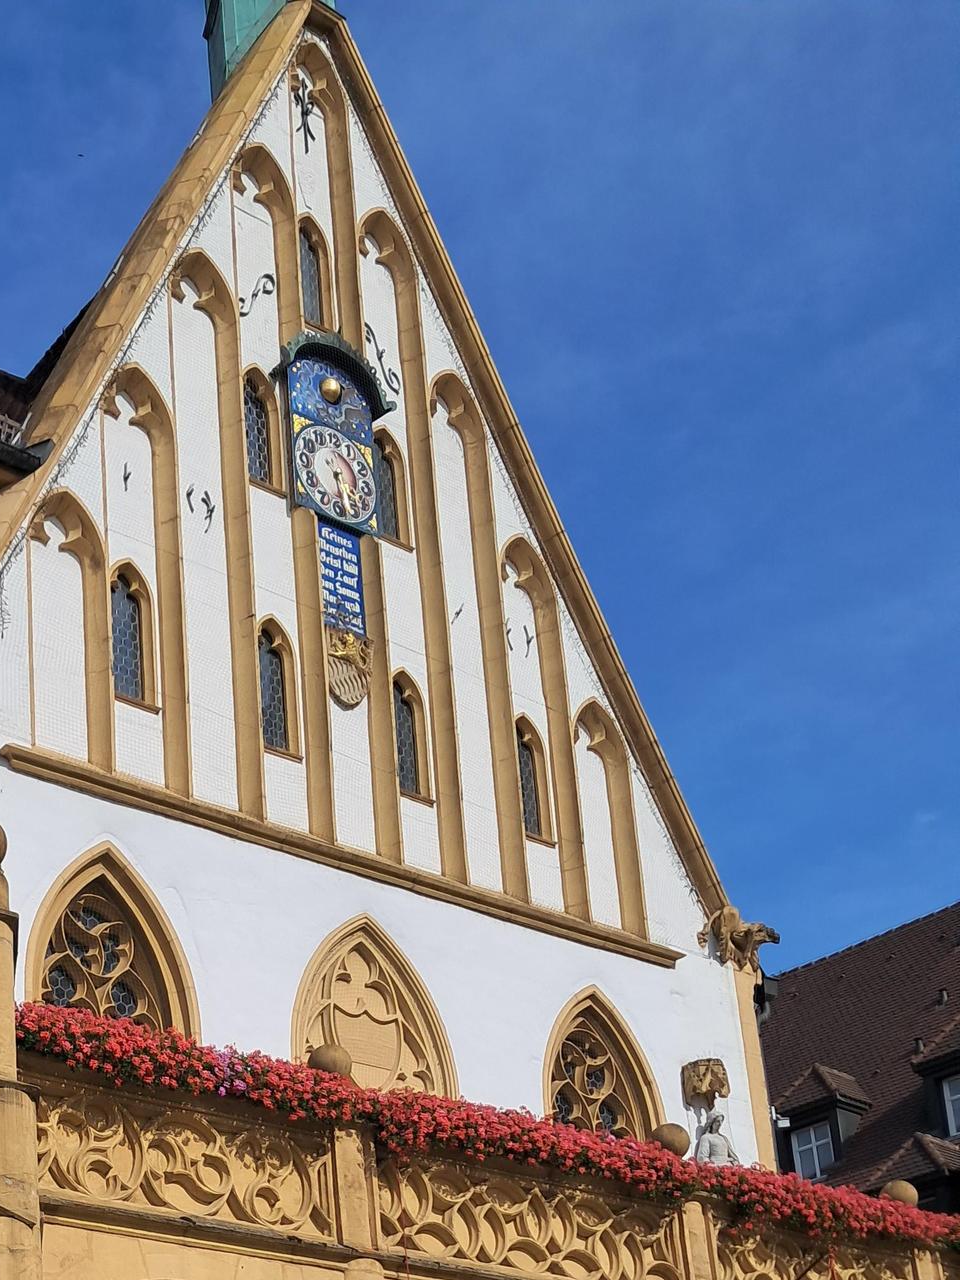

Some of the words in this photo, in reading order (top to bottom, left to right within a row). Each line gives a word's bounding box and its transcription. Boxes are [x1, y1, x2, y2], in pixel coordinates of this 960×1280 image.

[302, 436, 316, 453] 10
[327, 432, 342, 448] 12
[300, 451, 312, 468] 9
[357, 460, 368, 478] 2
[306, 470, 318, 487] 8
[360, 480, 373, 497] 3
[317, 489, 330, 506] 7
[321, 527, 353, 548] Keines
